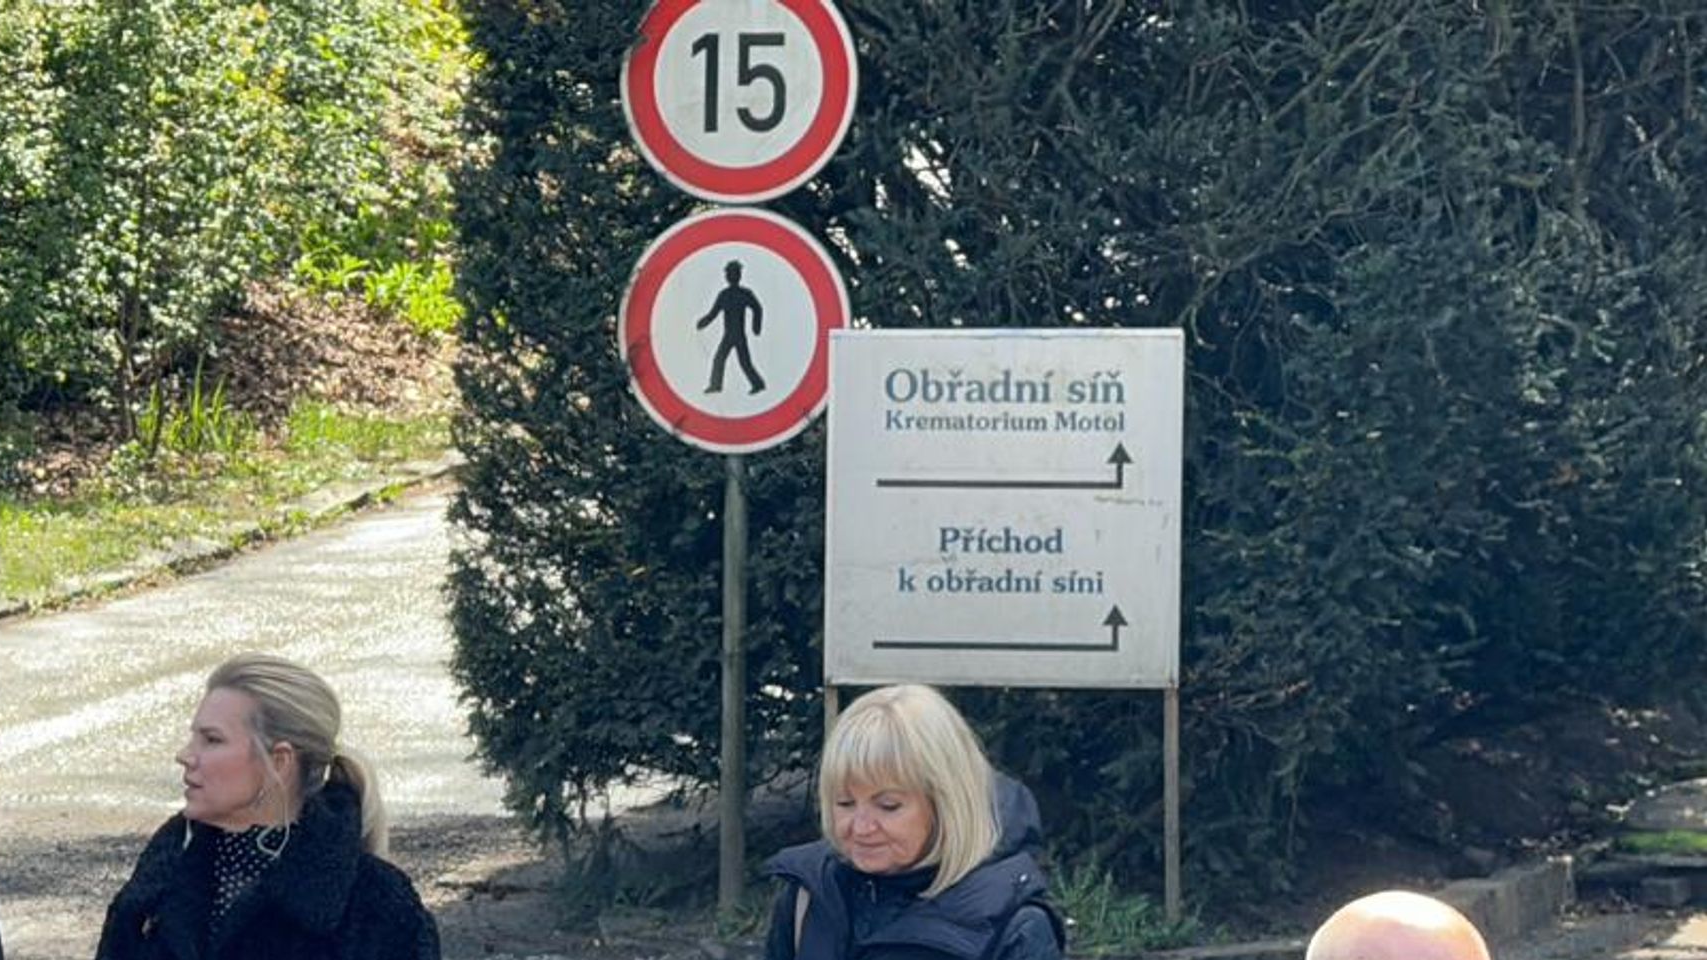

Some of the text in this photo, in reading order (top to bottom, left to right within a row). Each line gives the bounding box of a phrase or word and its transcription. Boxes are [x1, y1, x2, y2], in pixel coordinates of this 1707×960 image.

[691, 32, 786, 133] 15
[884, 368, 1126, 404] Obřadní síň
[884, 410, 1125, 432] Krematorium Motol
[939, 526, 1064, 554] Příchod
[898, 567, 1104, 594] k obřadní síni
